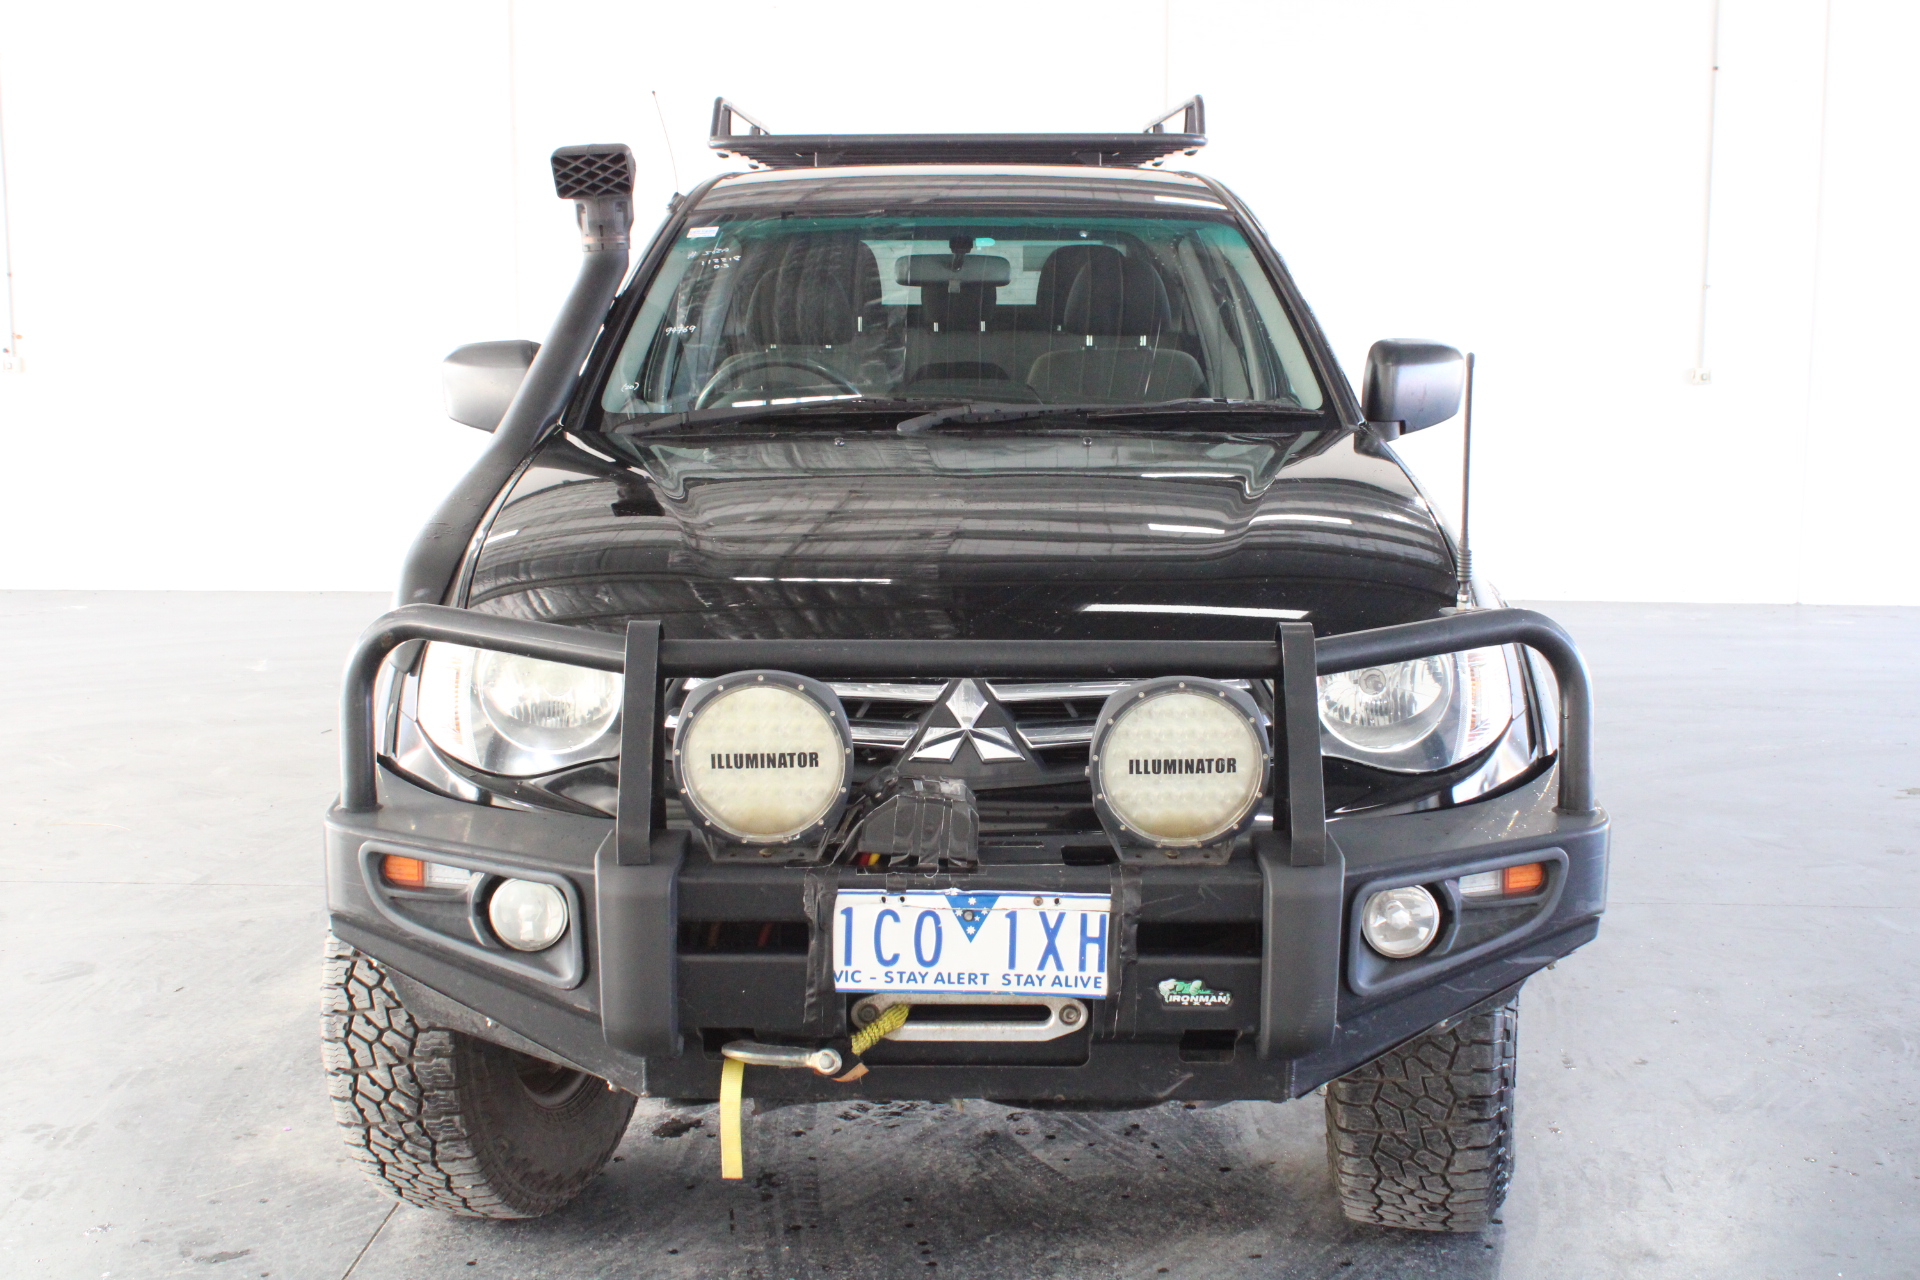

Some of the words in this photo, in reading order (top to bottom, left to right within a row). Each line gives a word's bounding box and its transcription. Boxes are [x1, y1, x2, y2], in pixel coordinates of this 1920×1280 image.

[711, 752, 819, 769] ILLUMINATOR
[1129, 758, 1237, 775] ILLUMINATOR
[1004, 910, 1107, 973] 1XH
[833, 969, 861, 983] VIC
[884, 970, 929, 984] STAY
[933, 971, 990, 985] ALERT
[1001, 973, 1046, 987] STAY
[1051, 974, 1102, 989] ALIVE
[1168, 994, 1227, 1003] IRONMAN
